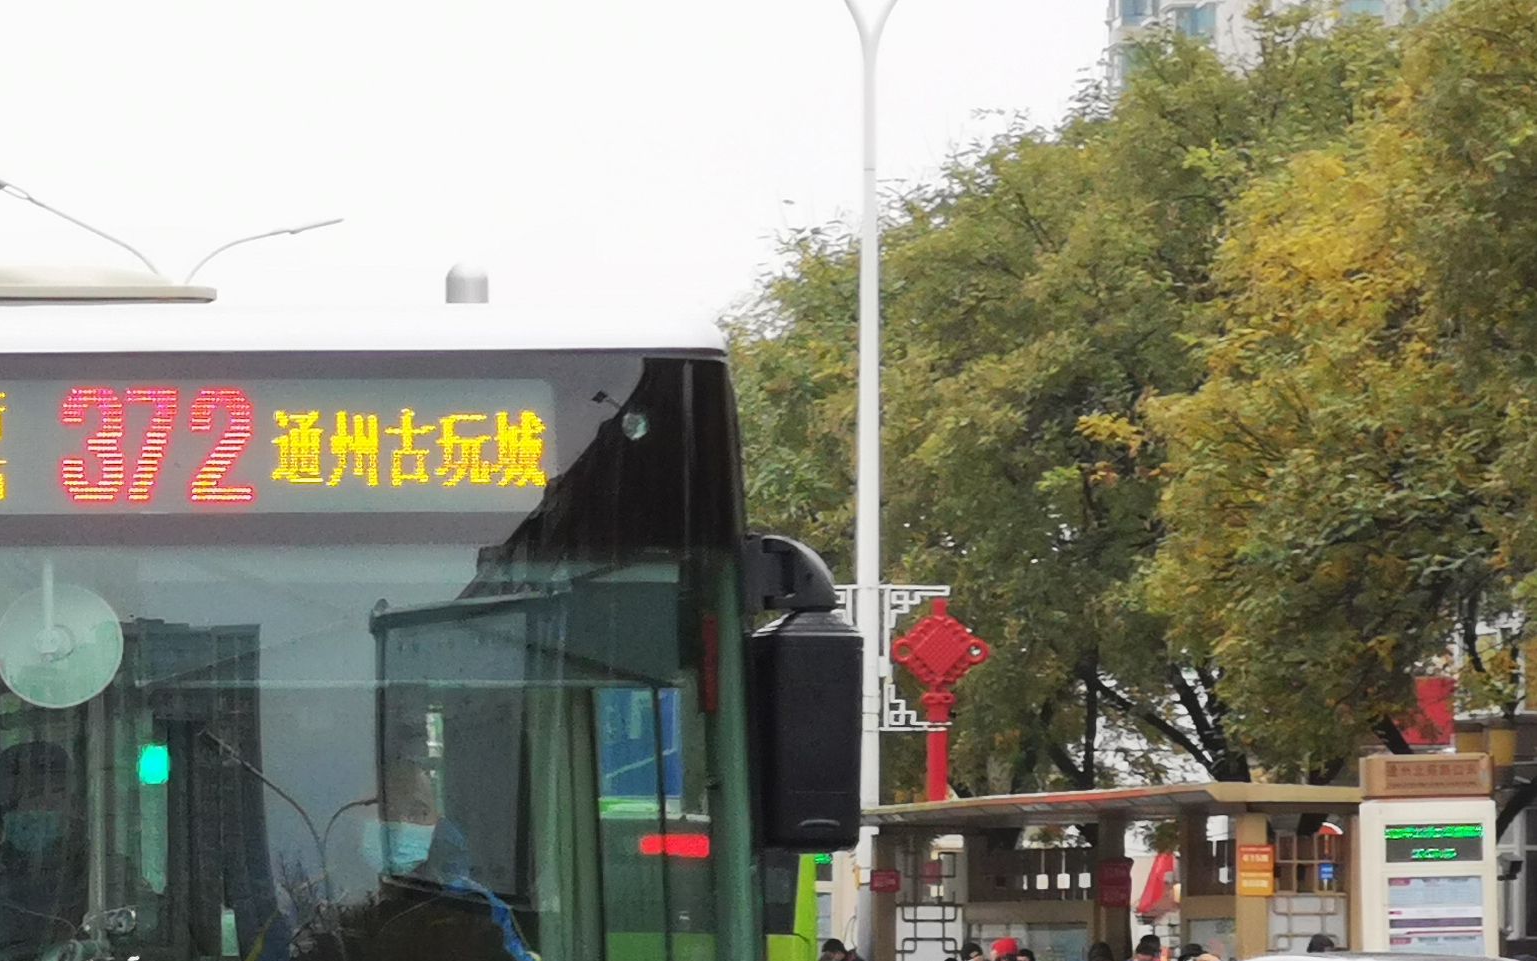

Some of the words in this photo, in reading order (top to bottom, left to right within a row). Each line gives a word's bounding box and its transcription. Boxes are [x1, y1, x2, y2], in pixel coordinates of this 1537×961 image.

[61, 387, 255, 501] 372
[271, 408, 547, 487] 通州古玩城
